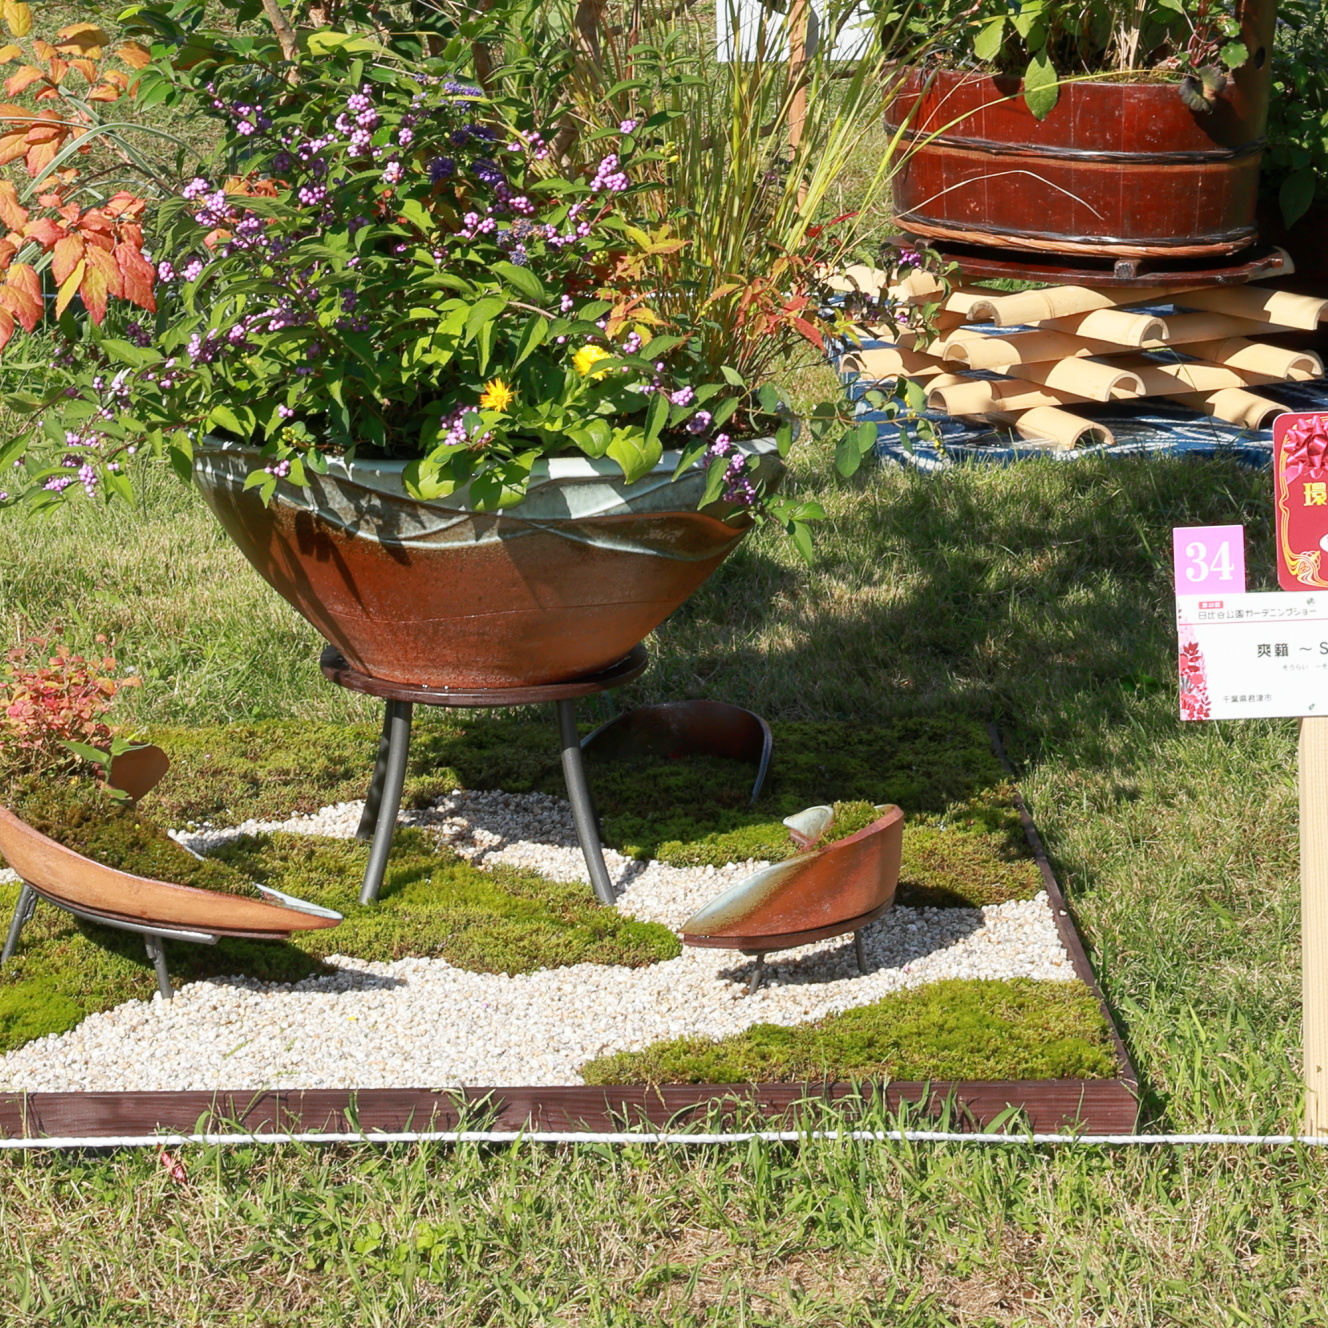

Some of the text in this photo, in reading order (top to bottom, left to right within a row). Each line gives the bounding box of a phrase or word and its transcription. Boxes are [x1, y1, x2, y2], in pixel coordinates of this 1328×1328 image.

[1184, 541, 1235, 583] 34
[1198, 607, 1318, 620] 日比谷公園ガーデニングショー
[1282, 663, 1309, 671] そうらい
[1223, 693, 1272, 703] 千葉県君津市
